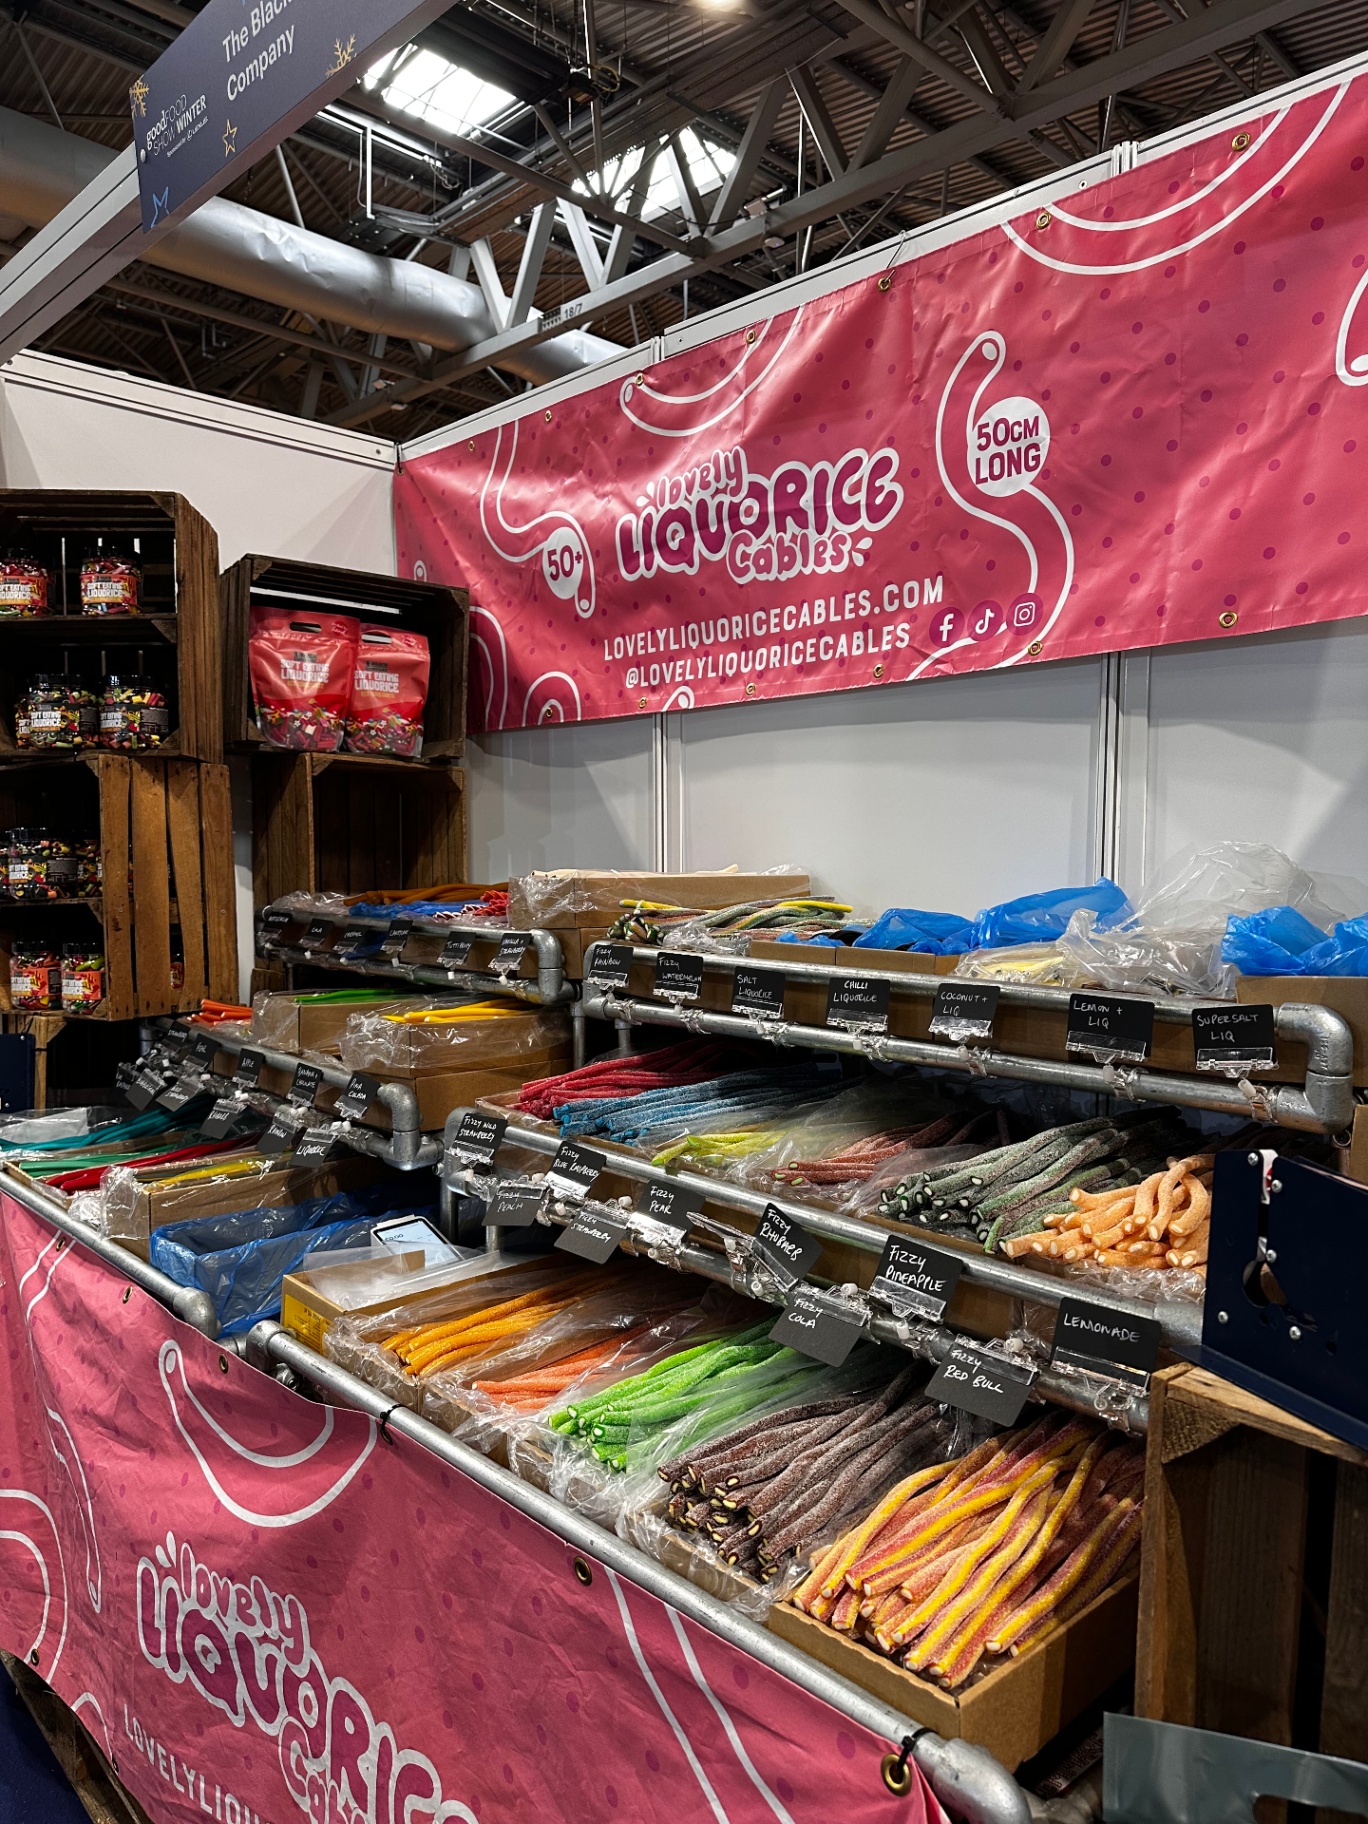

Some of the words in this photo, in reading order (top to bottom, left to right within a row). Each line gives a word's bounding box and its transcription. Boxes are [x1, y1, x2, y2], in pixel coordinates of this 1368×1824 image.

[222, 26, 249, 62] The
[227, 25, 295, 100] Company
[176, 95, 207, 134] WINTER
[564, 303, 583, 319] 18/7
[976, 414, 1041, 453] 50CM
[975, 441, 1042, 485] LONG
[656, 446, 749, 510] lovely
[615, 448, 904, 582] LIQUORICE
[548, 547, 584, 582] 50+
[726, 529, 851, 585] Cables
[603, 575, 944, 662] LOVELYLIQUORICECABLES.COM
[625, 622, 911, 689] @LOVELYLIQUORICECABLES
[659, 957, 680, 970] FIZZY
[737, 974, 757, 985] SALT
[844, 980, 869, 990] CHILLI
[738, 986, 773, 999] LIQUORICE
[833, 993, 878, 1004] LIQUORICE
[940, 990, 980, 1002] COCONUT
[943, 1005, 961, 1018] LIQ
[1073, 1001, 1111, 1014] LEMON
[1088, 1017, 1110, 1030] LIQ
[1211, 1030, 1235, 1043] LIQ
[553, 1158, 569, 1169] BLUE
[560, 1146, 580, 1163] FIZZY
[497, 1201, 524, 1213] PEACH
[649, 1200, 672, 1215] PEAR
[651, 1185, 675, 1205] FIZZY
[767, 1208, 793, 1234] FIZZY
[759, 1222, 804, 1262] RHUBARB
[888, 1244, 928, 1273] FIZZY
[885, 1264, 948, 1292] PINEAPPLE
[788, 1312, 817, 1329] COLA
[794, 1298, 824, 1318] FIZZY
[1063, 1312, 1141, 1343] LEMONADE
[950, 1349, 982, 1374] FIZZY
[943, 1364, 969, 1381] RED
[972, 1374, 1004, 1394] BULL
[180, 1543, 311, 1678] lovely
